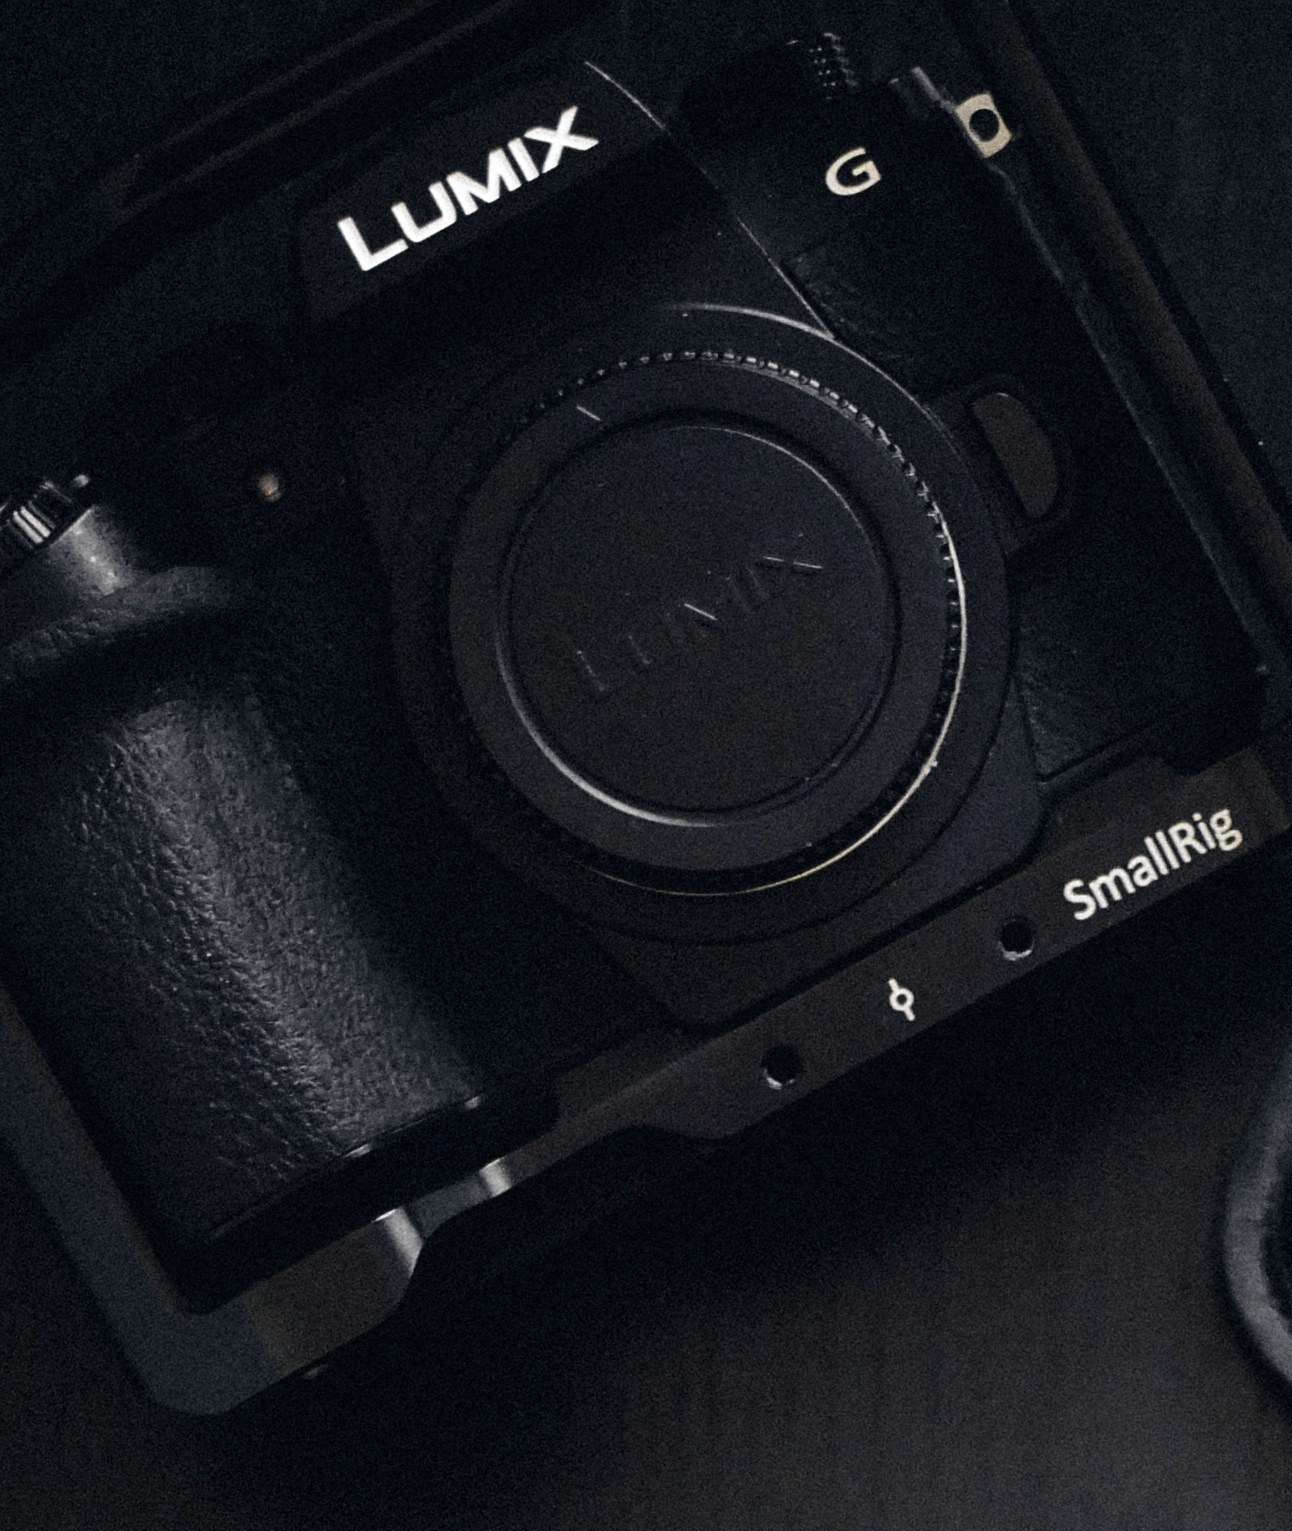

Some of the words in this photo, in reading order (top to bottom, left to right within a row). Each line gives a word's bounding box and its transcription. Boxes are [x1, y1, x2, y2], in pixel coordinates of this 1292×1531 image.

[337, 106, 599, 272] LUMIX
[825, 147, 881, 196] G
[1063, 808, 1243, 921] SmallRig
